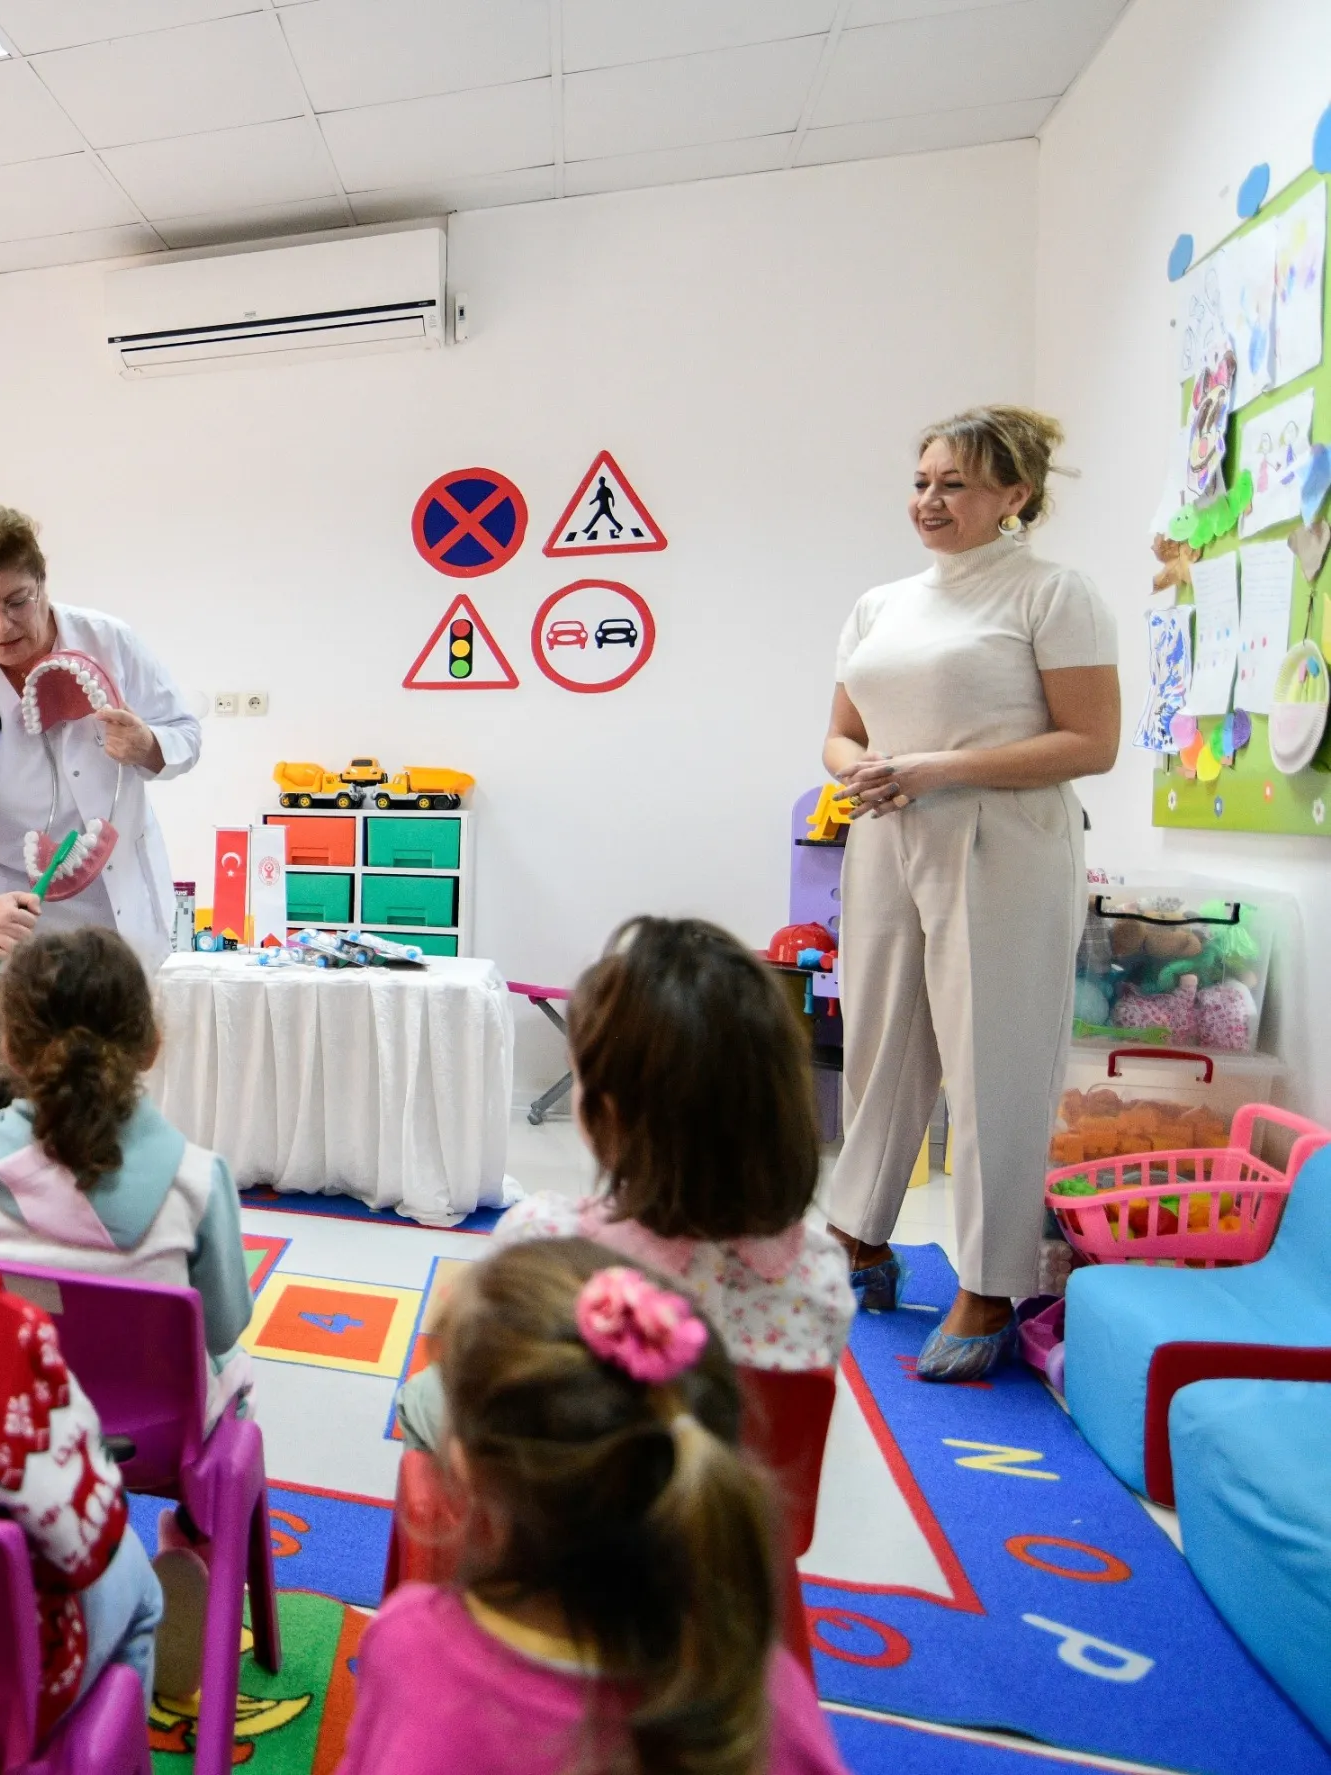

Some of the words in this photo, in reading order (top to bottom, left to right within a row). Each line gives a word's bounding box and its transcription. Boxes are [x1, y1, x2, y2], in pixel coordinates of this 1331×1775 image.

[298, 1311, 365, 1334] 4
[1004, 1534, 1132, 1584] O
[1022, 1613, 1154, 1683] P
